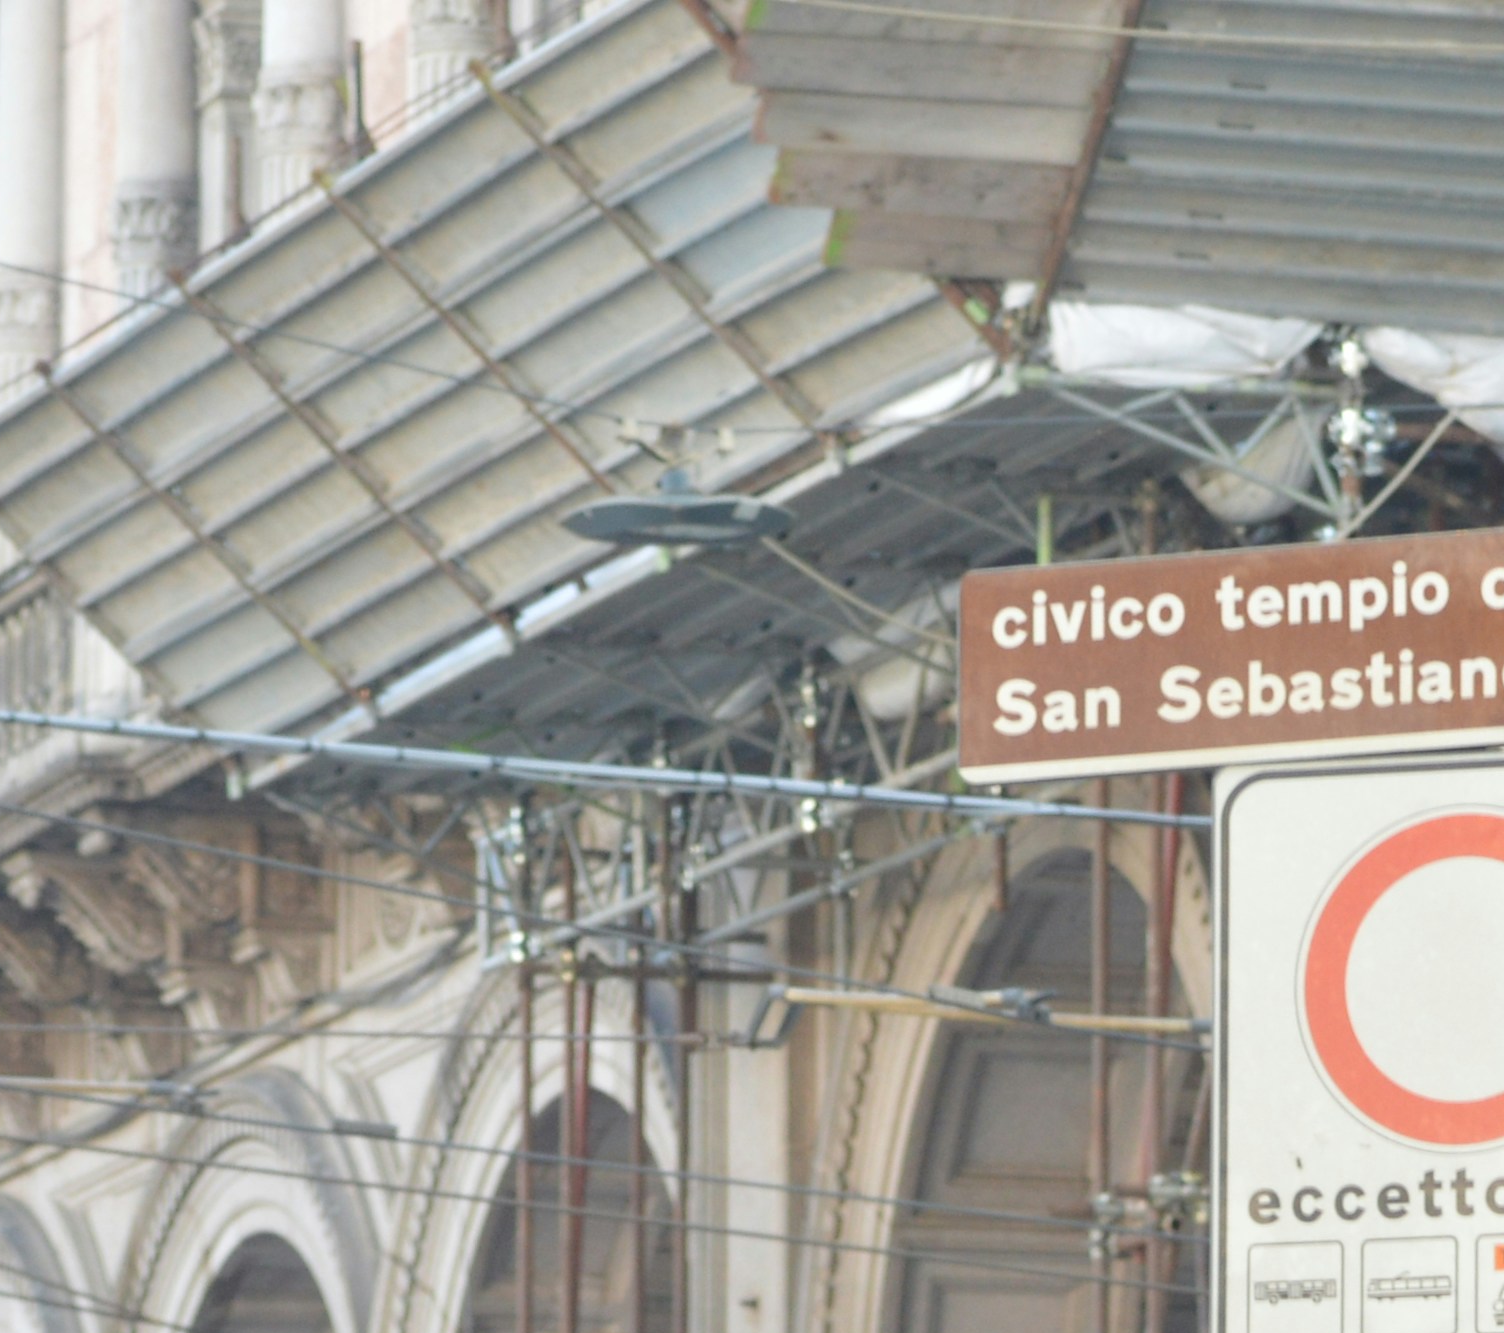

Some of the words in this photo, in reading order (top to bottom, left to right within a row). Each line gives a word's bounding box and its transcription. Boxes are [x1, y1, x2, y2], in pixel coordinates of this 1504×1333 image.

[992, 586, 1186, 649] civico
[1216, 560, 1451, 632] tempio
[993, 677, 1123, 736] San
